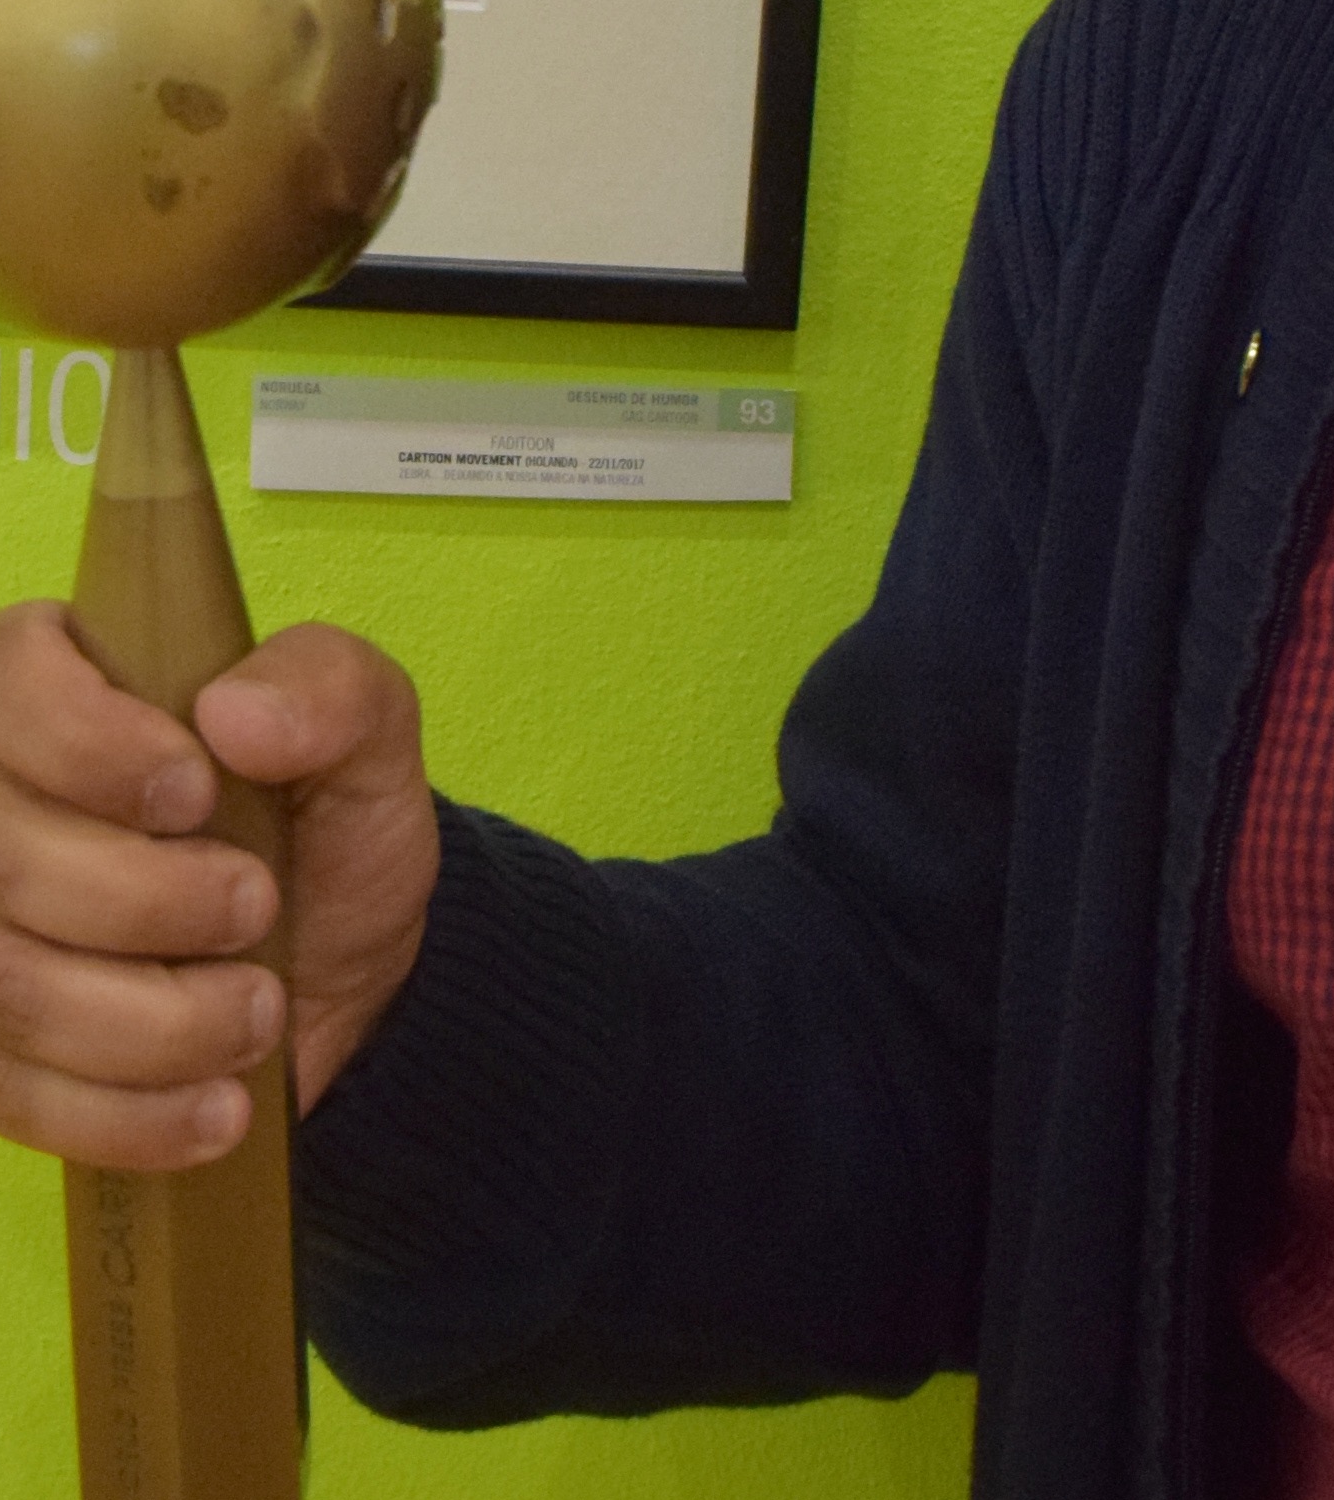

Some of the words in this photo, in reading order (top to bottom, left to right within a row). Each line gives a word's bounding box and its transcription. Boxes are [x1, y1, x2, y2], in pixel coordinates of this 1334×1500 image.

[630, 392, 647, 406] DE
[740, 398, 776, 426] 93
[490, 435, 555, 452] FADITOON
[398, 452, 452, 465] CARTOON
[455, 454, 522, 467] MOVEMENT
[587, 458, 645, 471] 22/11/2017
